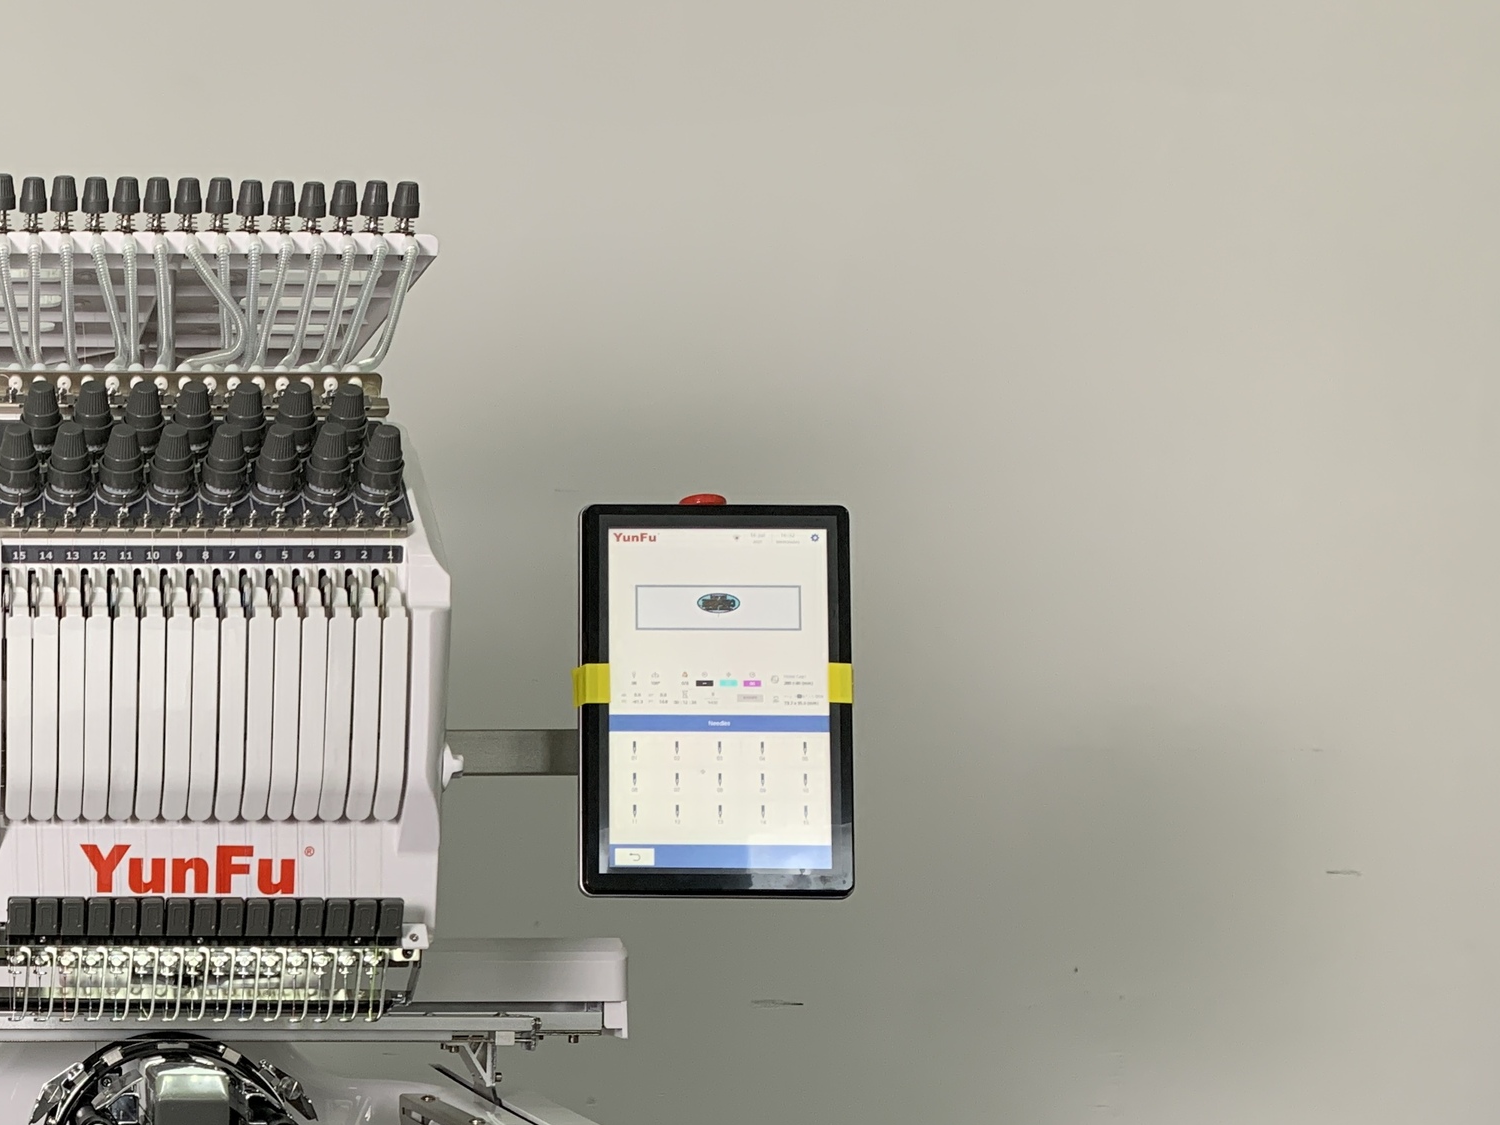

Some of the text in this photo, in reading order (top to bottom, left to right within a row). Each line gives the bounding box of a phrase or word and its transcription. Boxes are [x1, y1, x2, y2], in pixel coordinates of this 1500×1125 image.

[613, 532, 657, 542] YunFu
[12, 551, 394, 560] 15 14 13 12 11 10 9 8 7 6 5 4 3 2 1
[80, 844, 296, 894] YunFu
